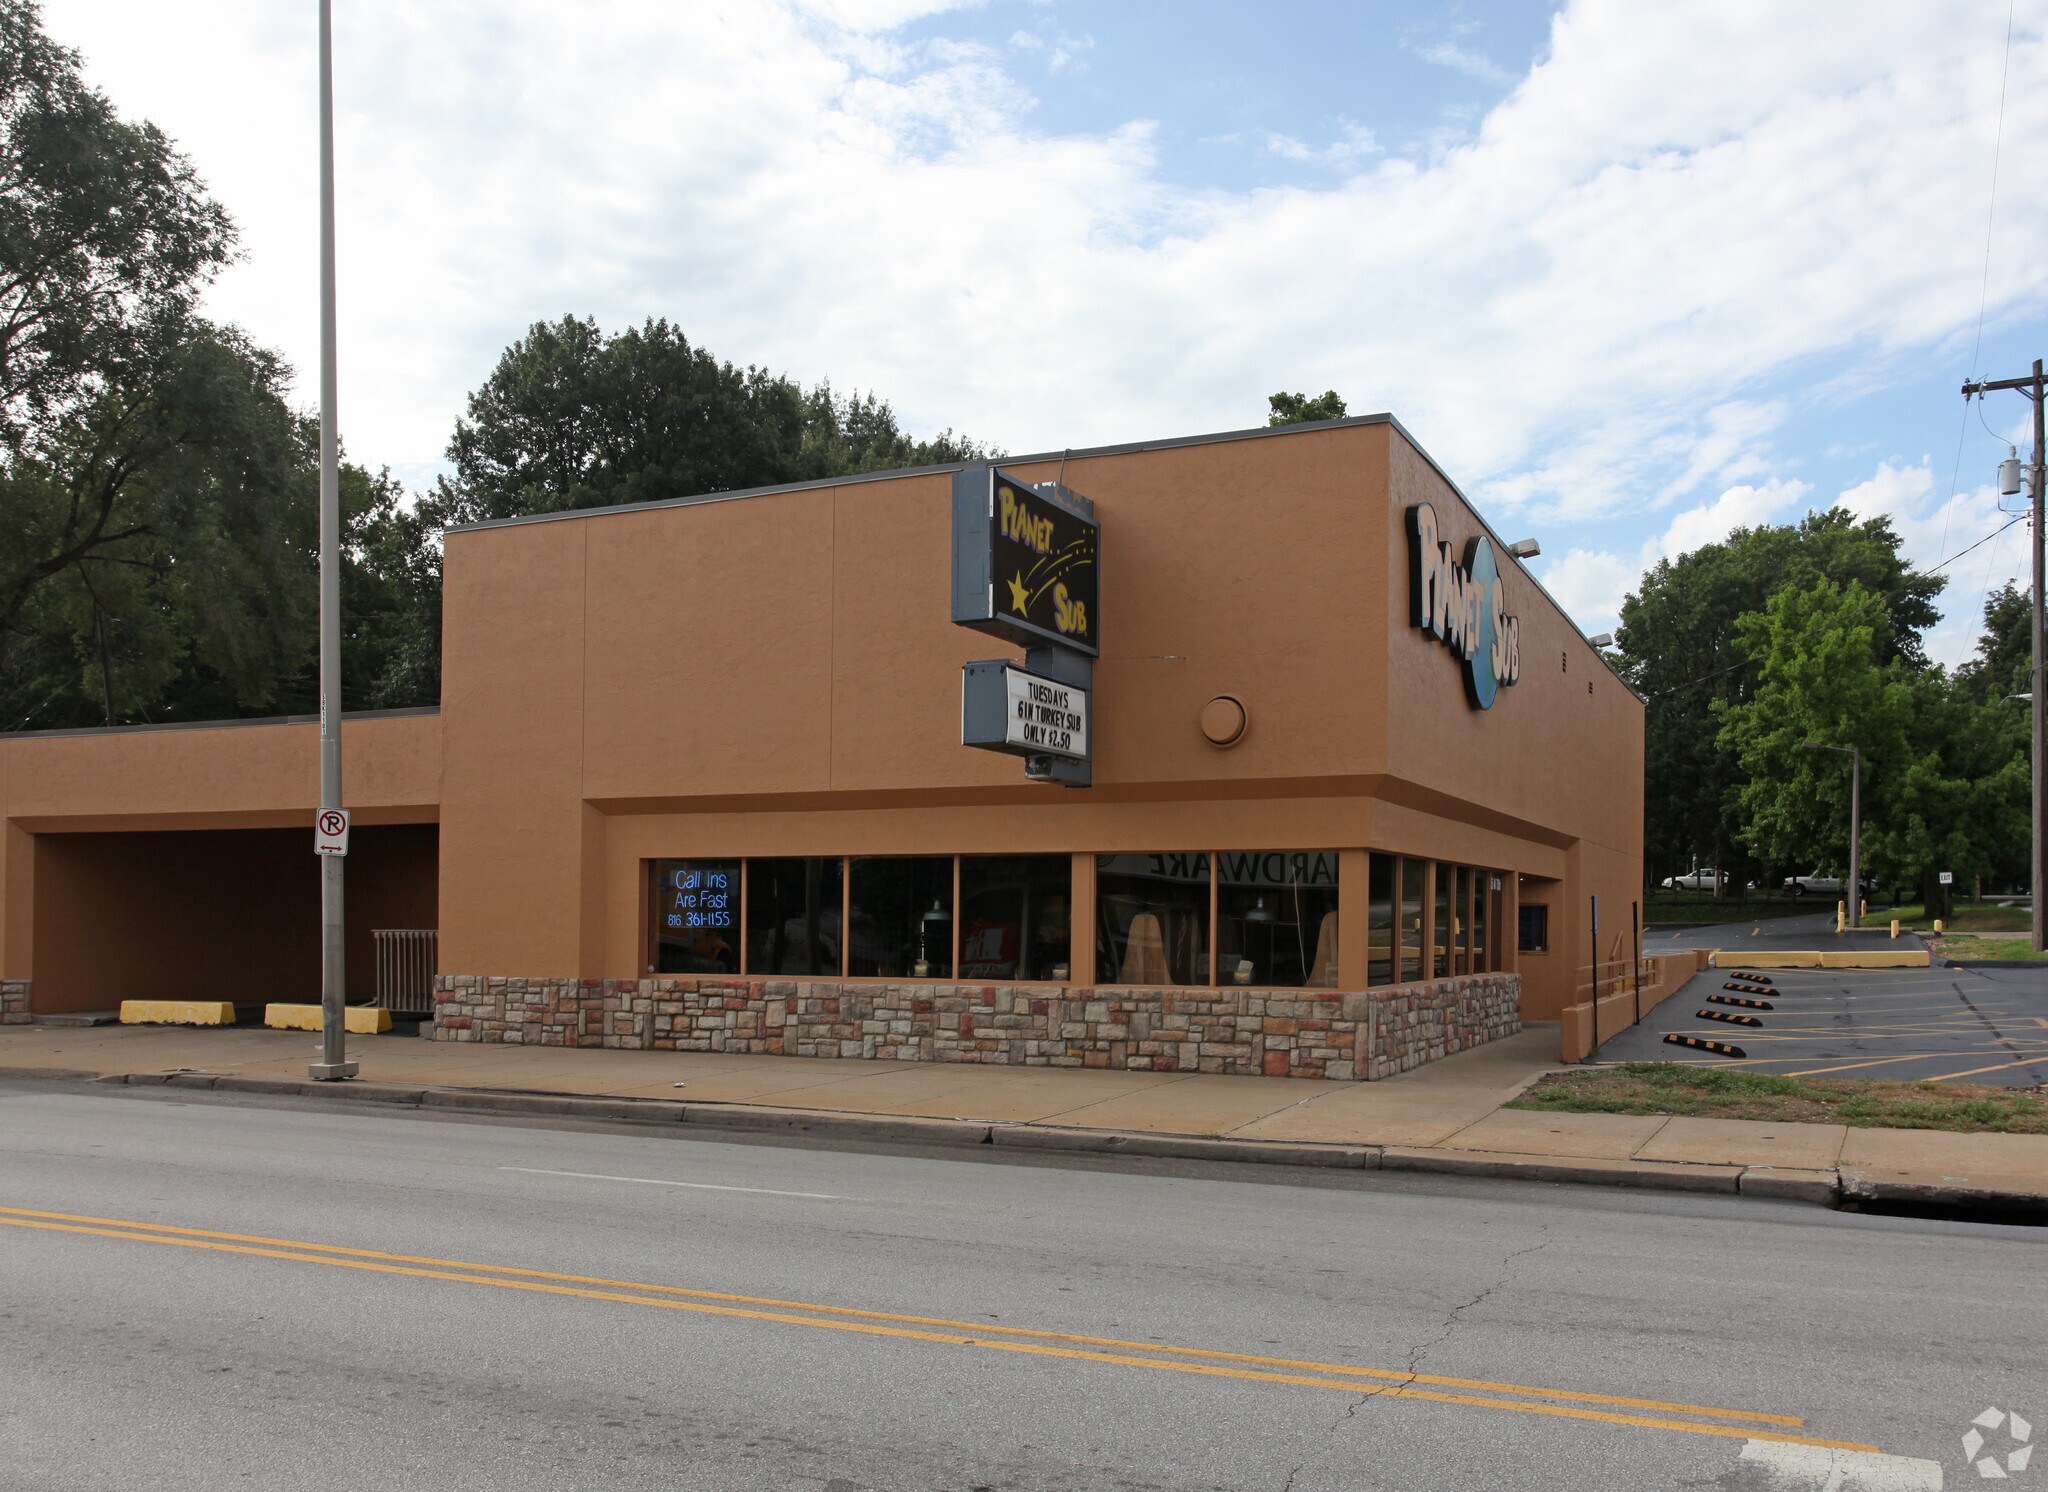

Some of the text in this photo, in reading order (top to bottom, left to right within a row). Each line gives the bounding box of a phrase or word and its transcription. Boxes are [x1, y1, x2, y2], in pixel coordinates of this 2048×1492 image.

[998, 487, 1054, 554] PLANET
[1417, 502, 1520, 683] PLANET SUB
[1053, 583, 1087, 635] SUB
[1027, 681, 1069, 708] TUESDAYS
[1034, 704, 1066, 728] TURKEY
[1066, 712, 1082, 732] SUB
[1023, 723, 1071, 750] ONLY $2.50
[675, 870, 727, 890] Call Ins
[674, 890, 729, 909] Are Fast
[667, 911, 730, 926] 816 361-1155
